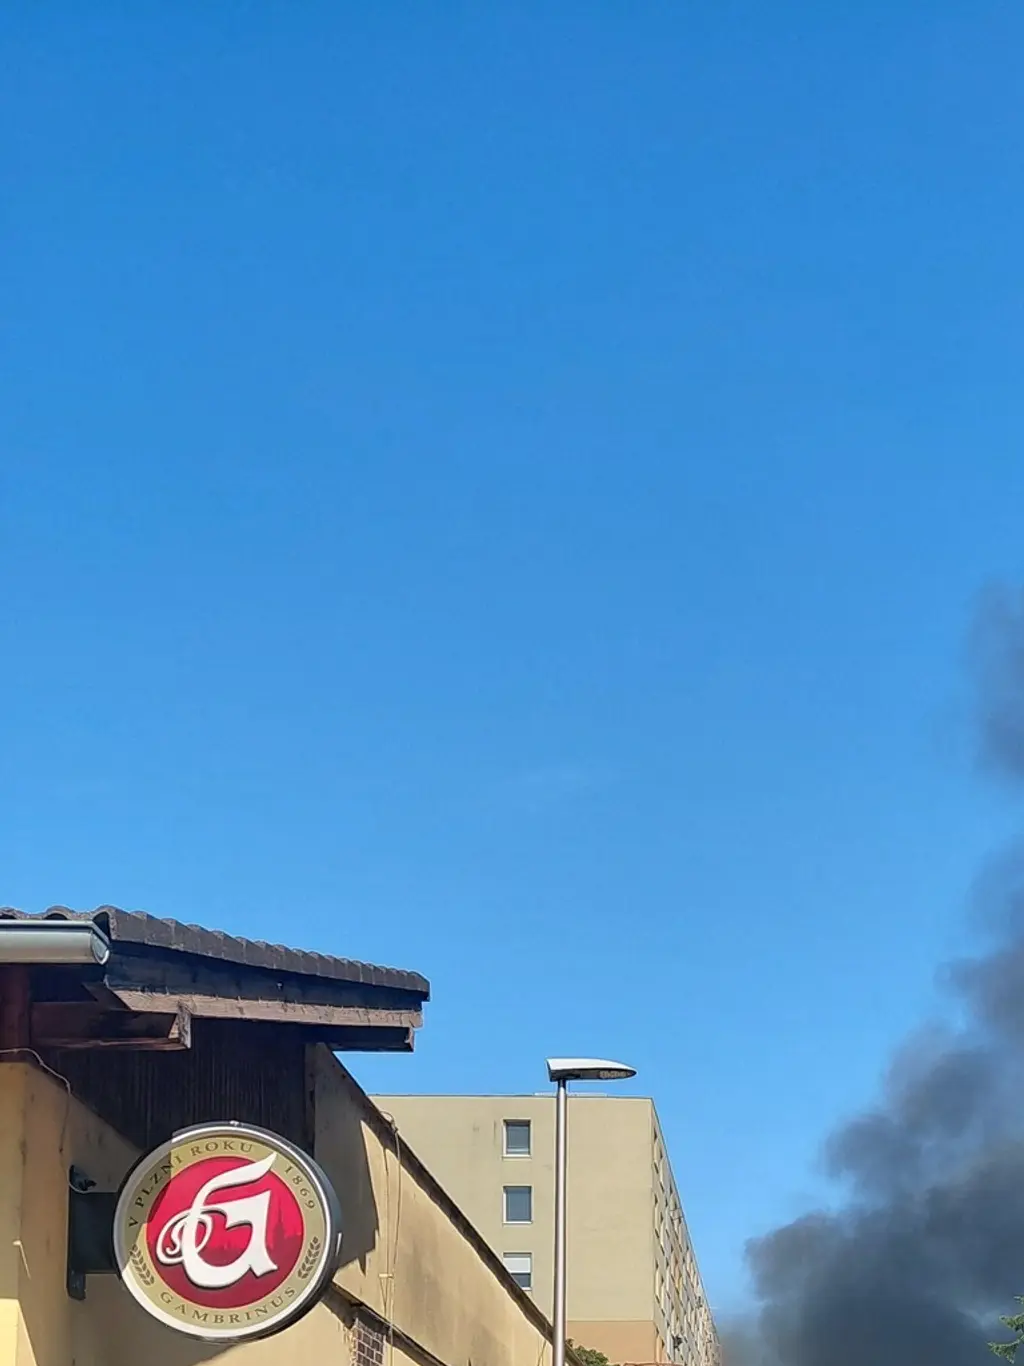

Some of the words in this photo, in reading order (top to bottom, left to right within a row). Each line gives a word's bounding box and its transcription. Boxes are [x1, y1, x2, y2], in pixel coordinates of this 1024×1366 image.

[129, 1216, 139, 1228] V
[190, 1140, 255, 1157] ROKU
[284, 1165, 316, 1211] 1869
[159, 1286, 296, 1325] GAMBRINUS
